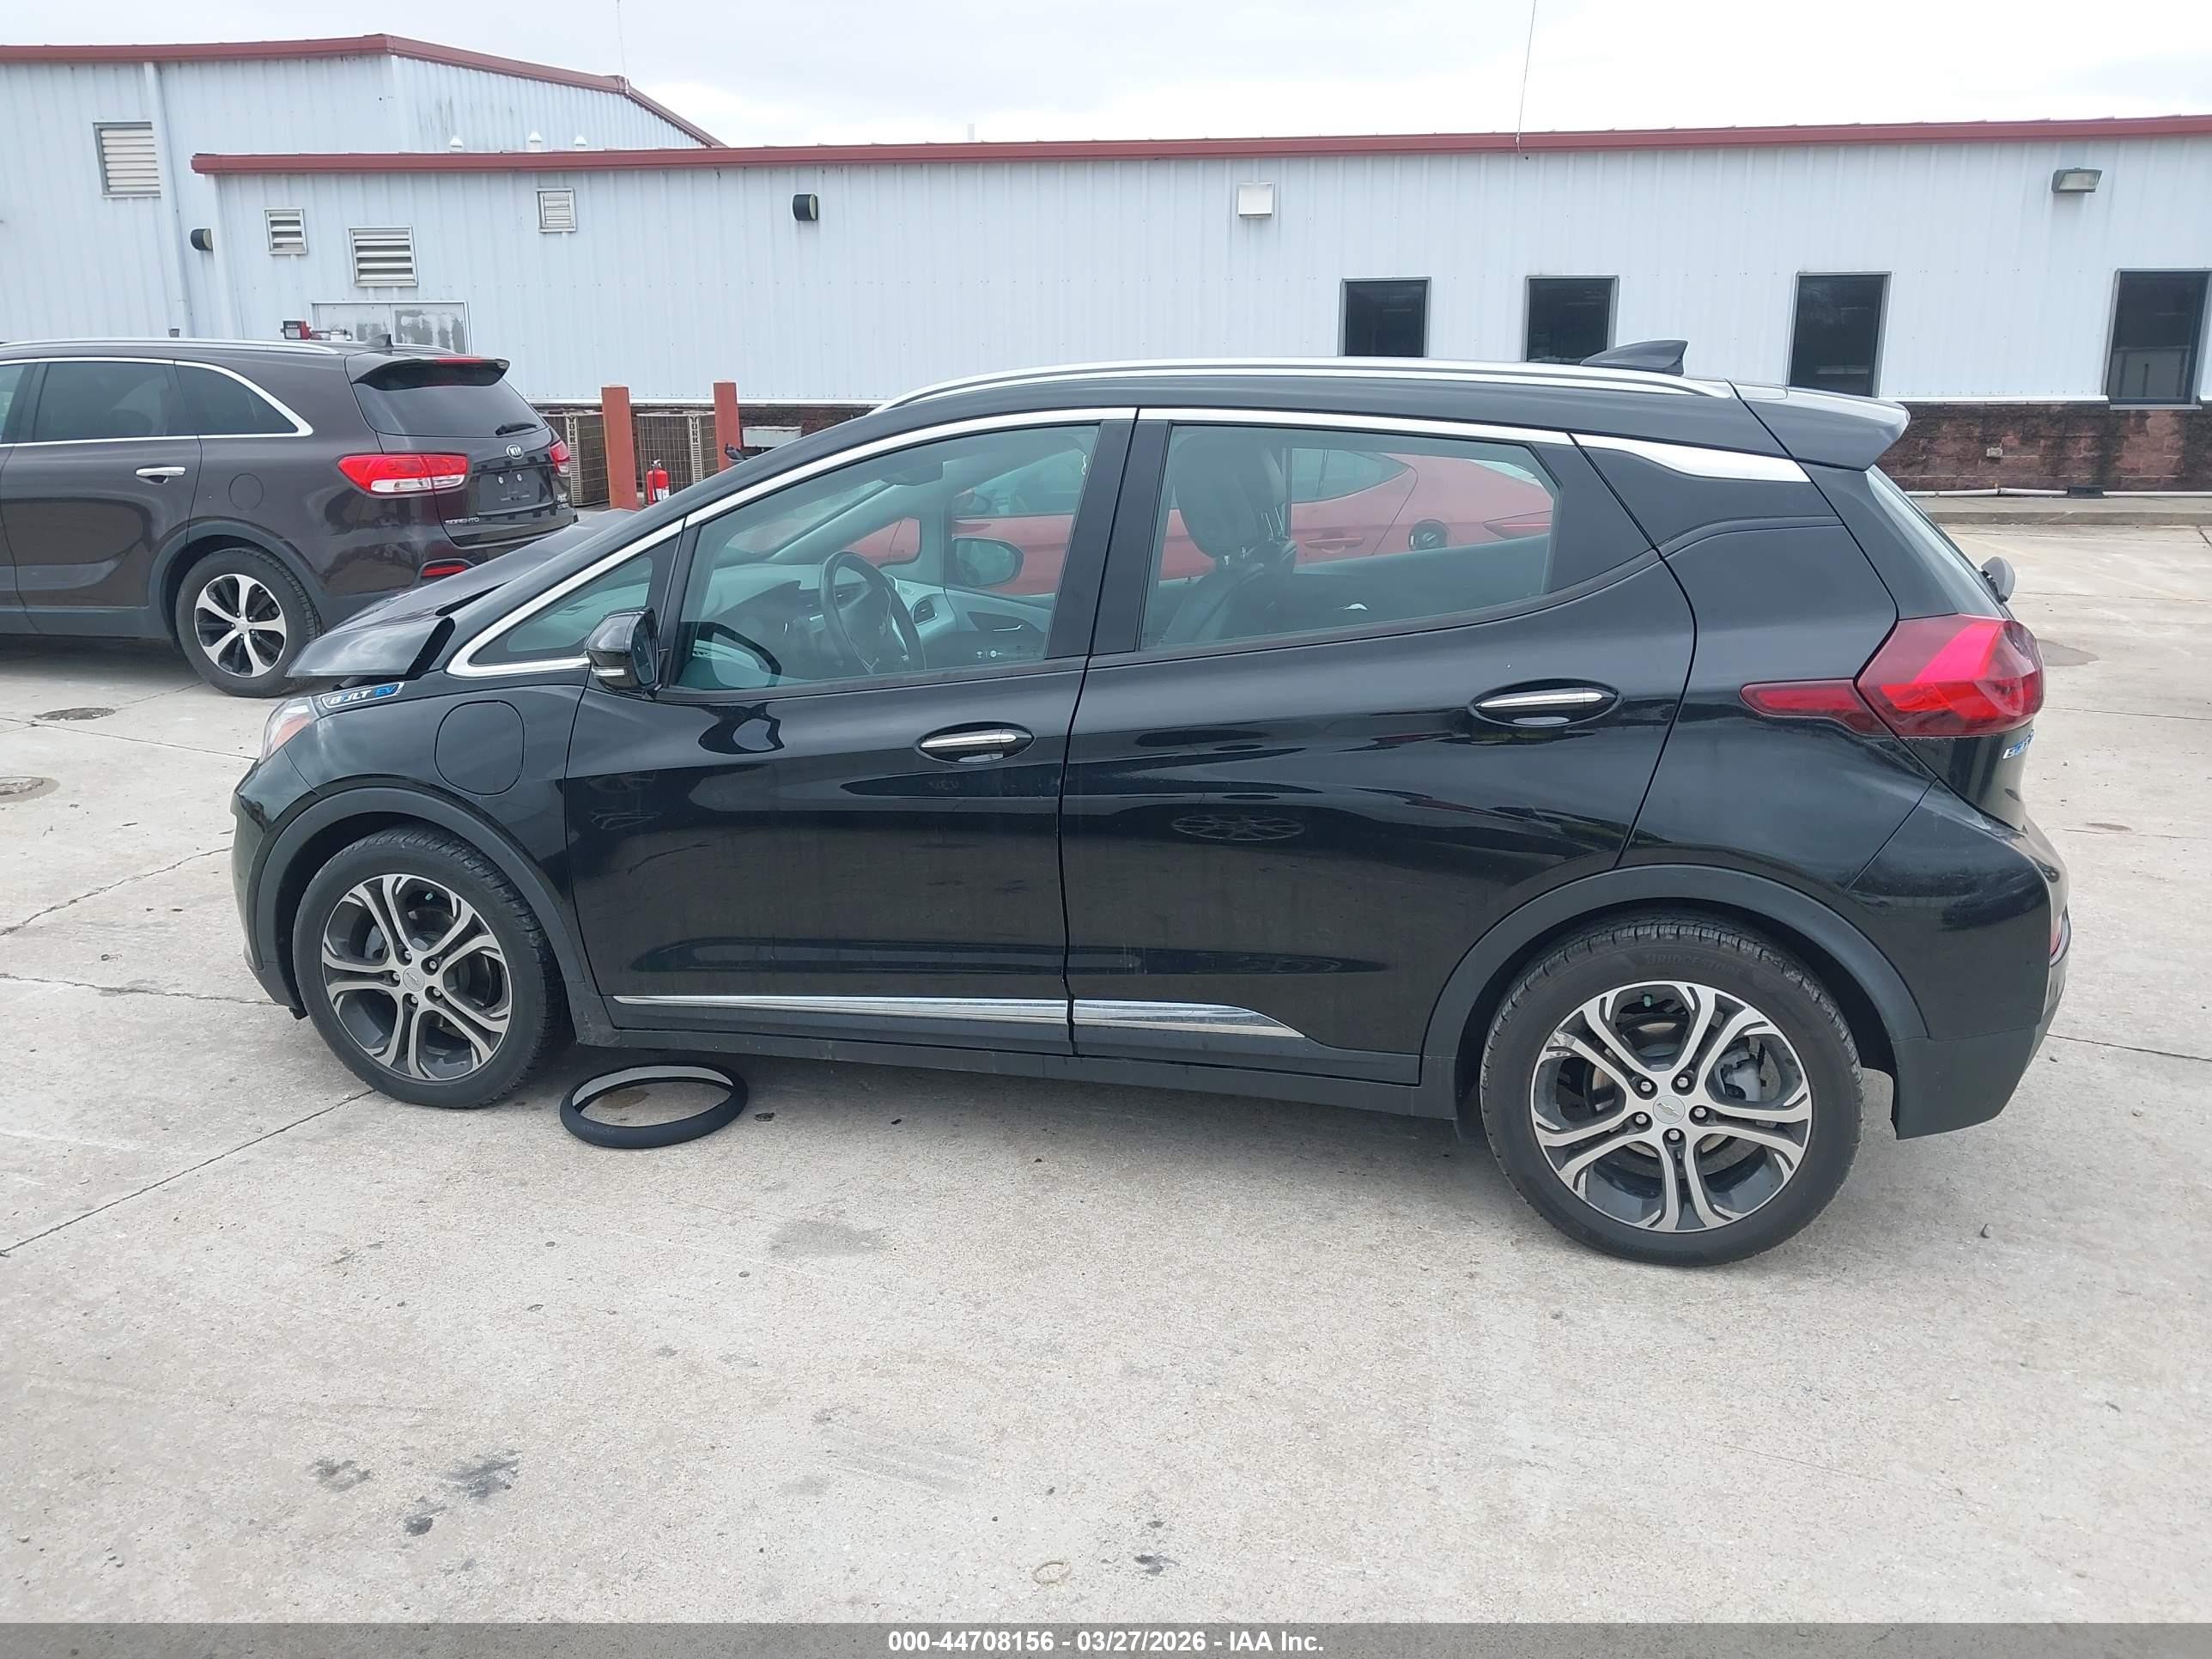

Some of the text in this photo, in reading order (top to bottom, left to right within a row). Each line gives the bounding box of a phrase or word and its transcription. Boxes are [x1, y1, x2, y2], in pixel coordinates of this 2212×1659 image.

[568, 416, 576, 444] YORK
[689, 416, 699, 444] YORK
[375, 685, 398, 696] EV
